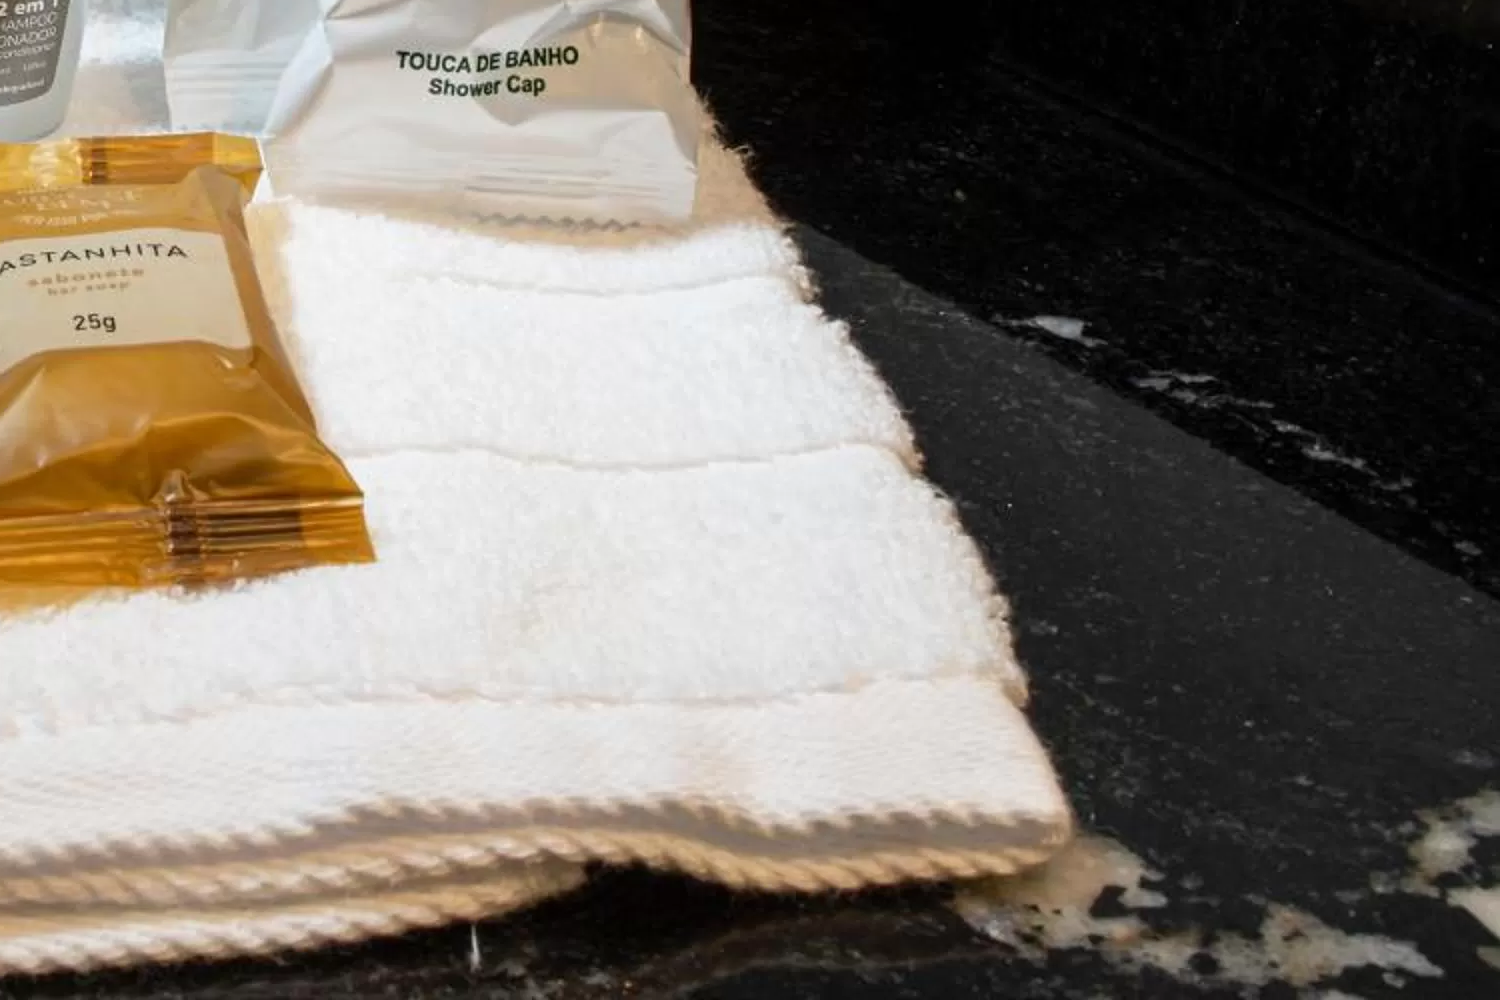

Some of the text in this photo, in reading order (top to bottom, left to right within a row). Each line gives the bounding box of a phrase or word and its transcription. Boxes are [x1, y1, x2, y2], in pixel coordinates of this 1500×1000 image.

[14, 0, 45, 15] em
[396, 45, 579, 73] TOUCA DE BANHO
[428, 74, 546, 98] Shower Cap
[72, 312, 117, 333] 25g
